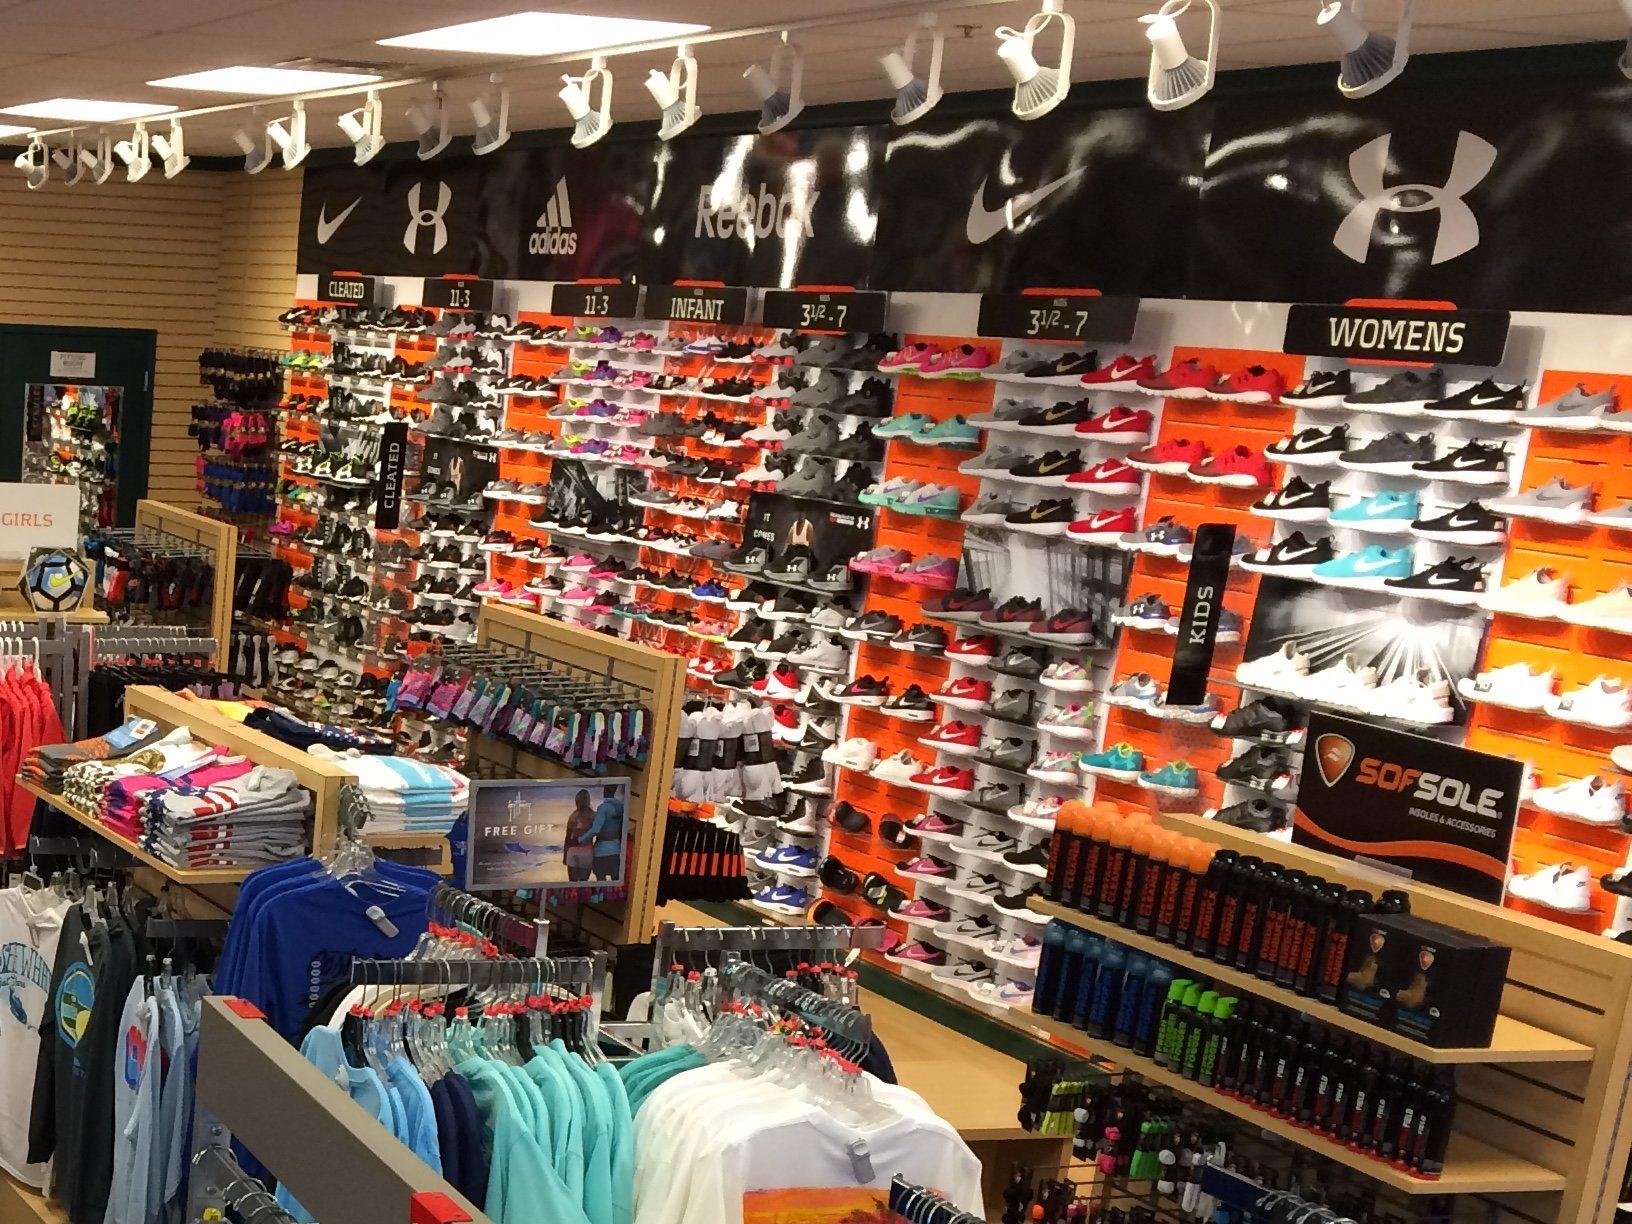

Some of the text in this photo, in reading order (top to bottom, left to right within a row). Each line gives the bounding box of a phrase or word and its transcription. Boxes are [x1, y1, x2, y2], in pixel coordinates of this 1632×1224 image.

[529, 224, 577, 255] adidas
[329, 281, 364, 299] CLEATED
[450, 289, 470, 308] 11-3
[584, 294, 609, 315] 11-3
[670, 297, 725, 321] INFANT
[1328, 317, 1466, 354] WOMENS
[384, 442, 400, 509] CLEATED
[1, 513, 53, 528] GIRLS
[1189, 586, 1214, 644] KIDS
[484, 823, 554, 837] FREE GIFT
[1408, 807, 1439, 823] INSOLES
[1445, 817, 1496, 839] ACCESSORIES
[1403, 1107, 1414, 1128] FIELD
